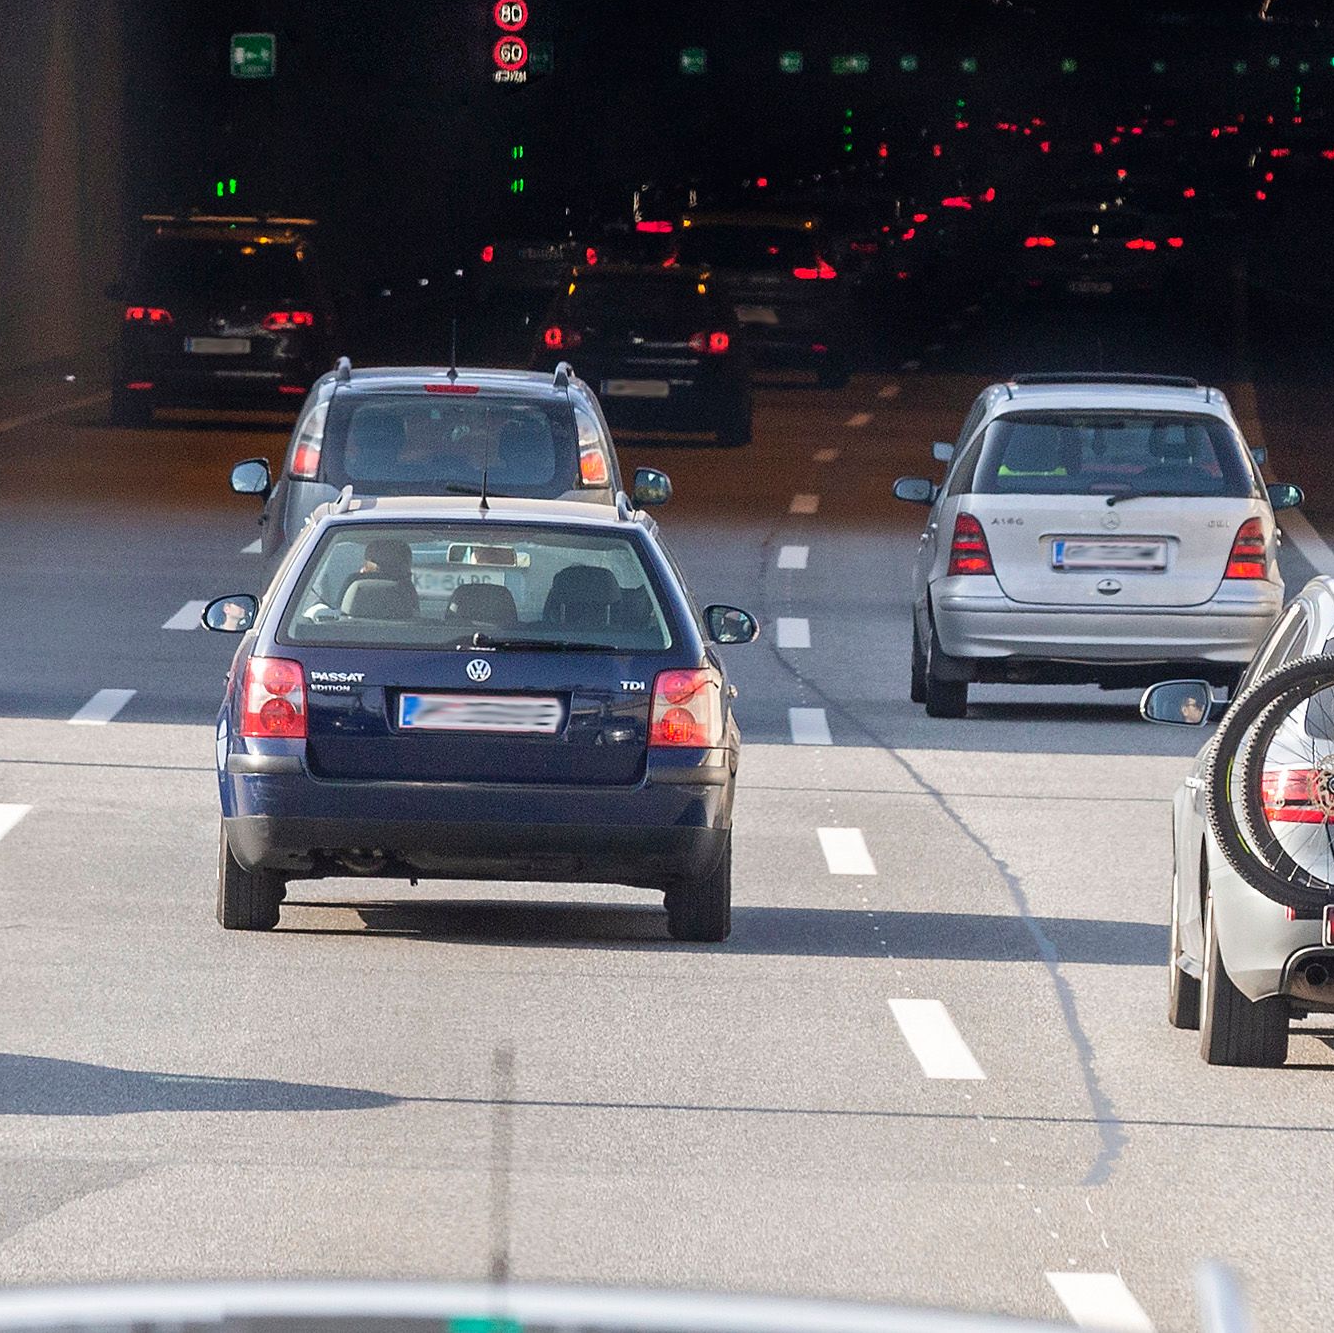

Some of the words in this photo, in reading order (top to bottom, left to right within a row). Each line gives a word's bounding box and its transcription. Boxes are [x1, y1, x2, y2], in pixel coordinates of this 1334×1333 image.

[501, 4, 523, 23] 80
[500, 44, 523, 63] 60
[311, 671, 365, 683] PASSAT
[311, 684, 351, 692] EDITION
[620, 680, 646, 691] TDI
